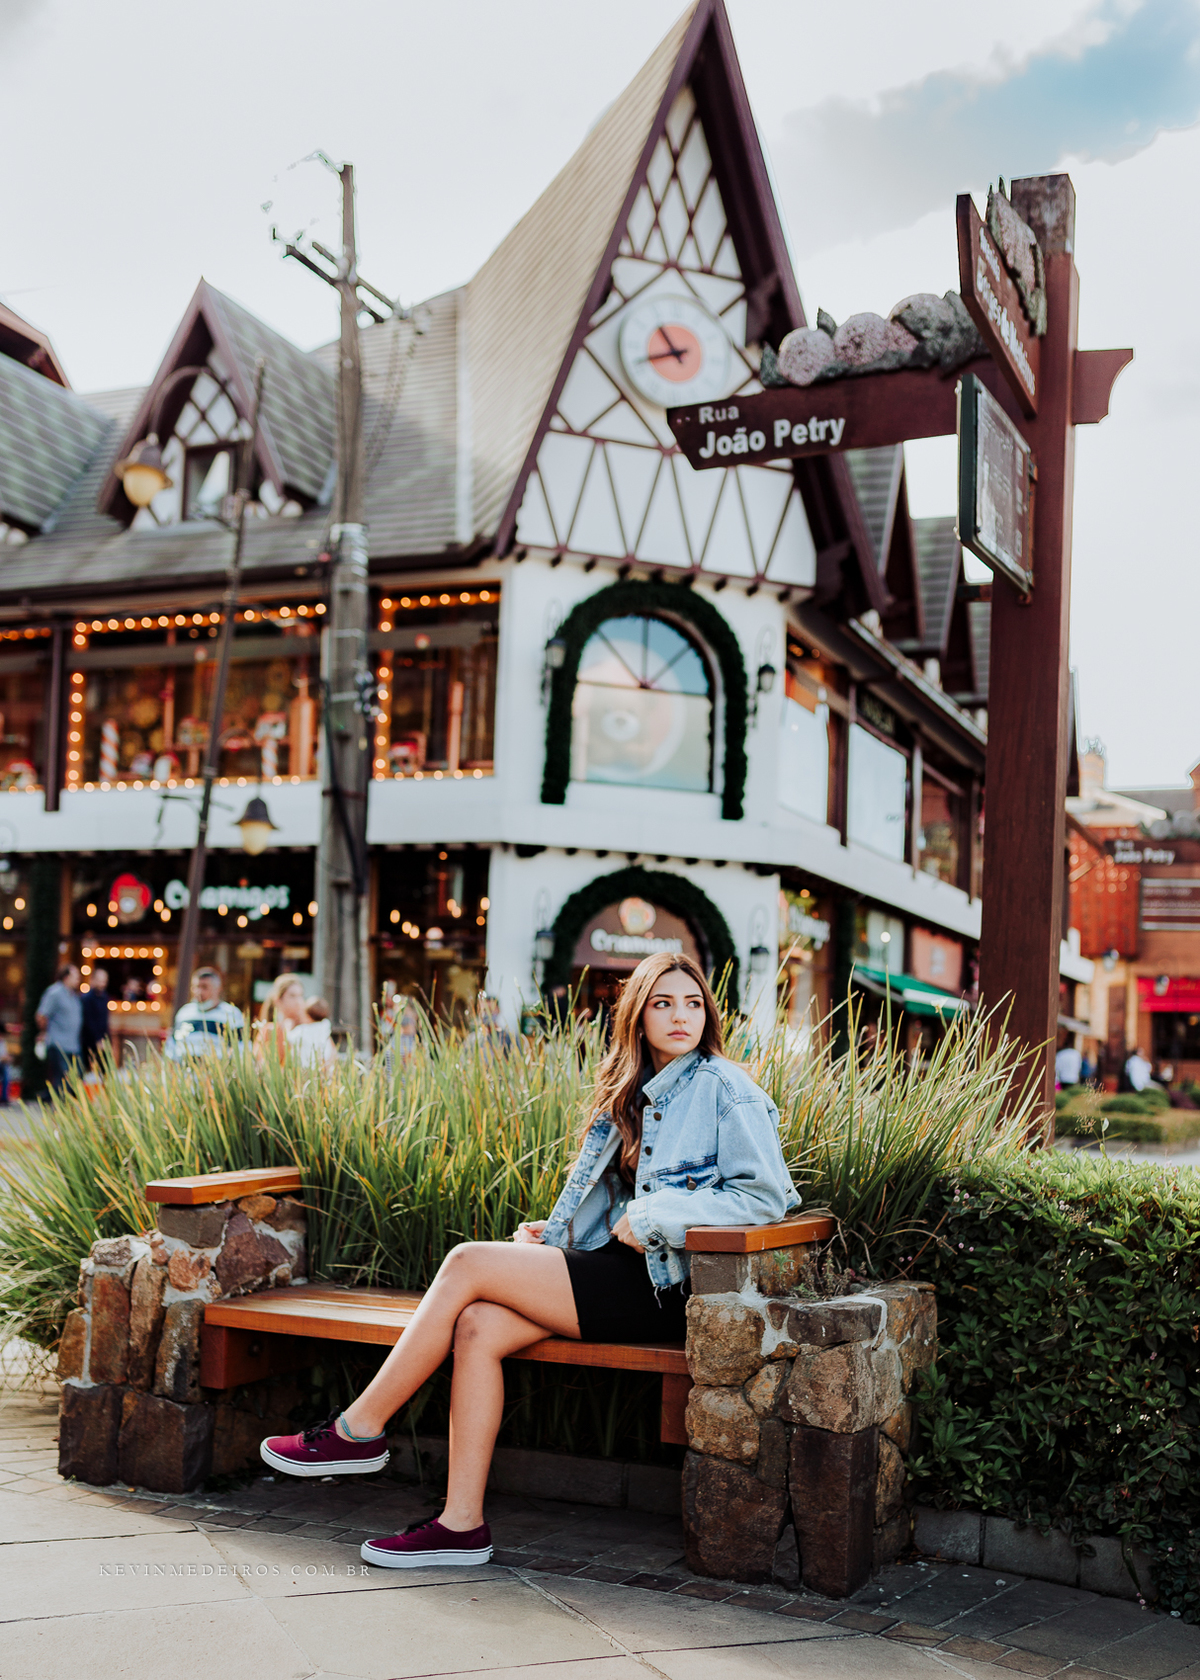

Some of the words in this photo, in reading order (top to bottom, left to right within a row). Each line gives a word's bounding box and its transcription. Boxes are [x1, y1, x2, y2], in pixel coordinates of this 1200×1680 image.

[699, 406, 739, 424] Rua
[699, 427, 766, 458] João
[774, 415, 846, 447] Petry
[164, 879, 290, 920] Camigos
